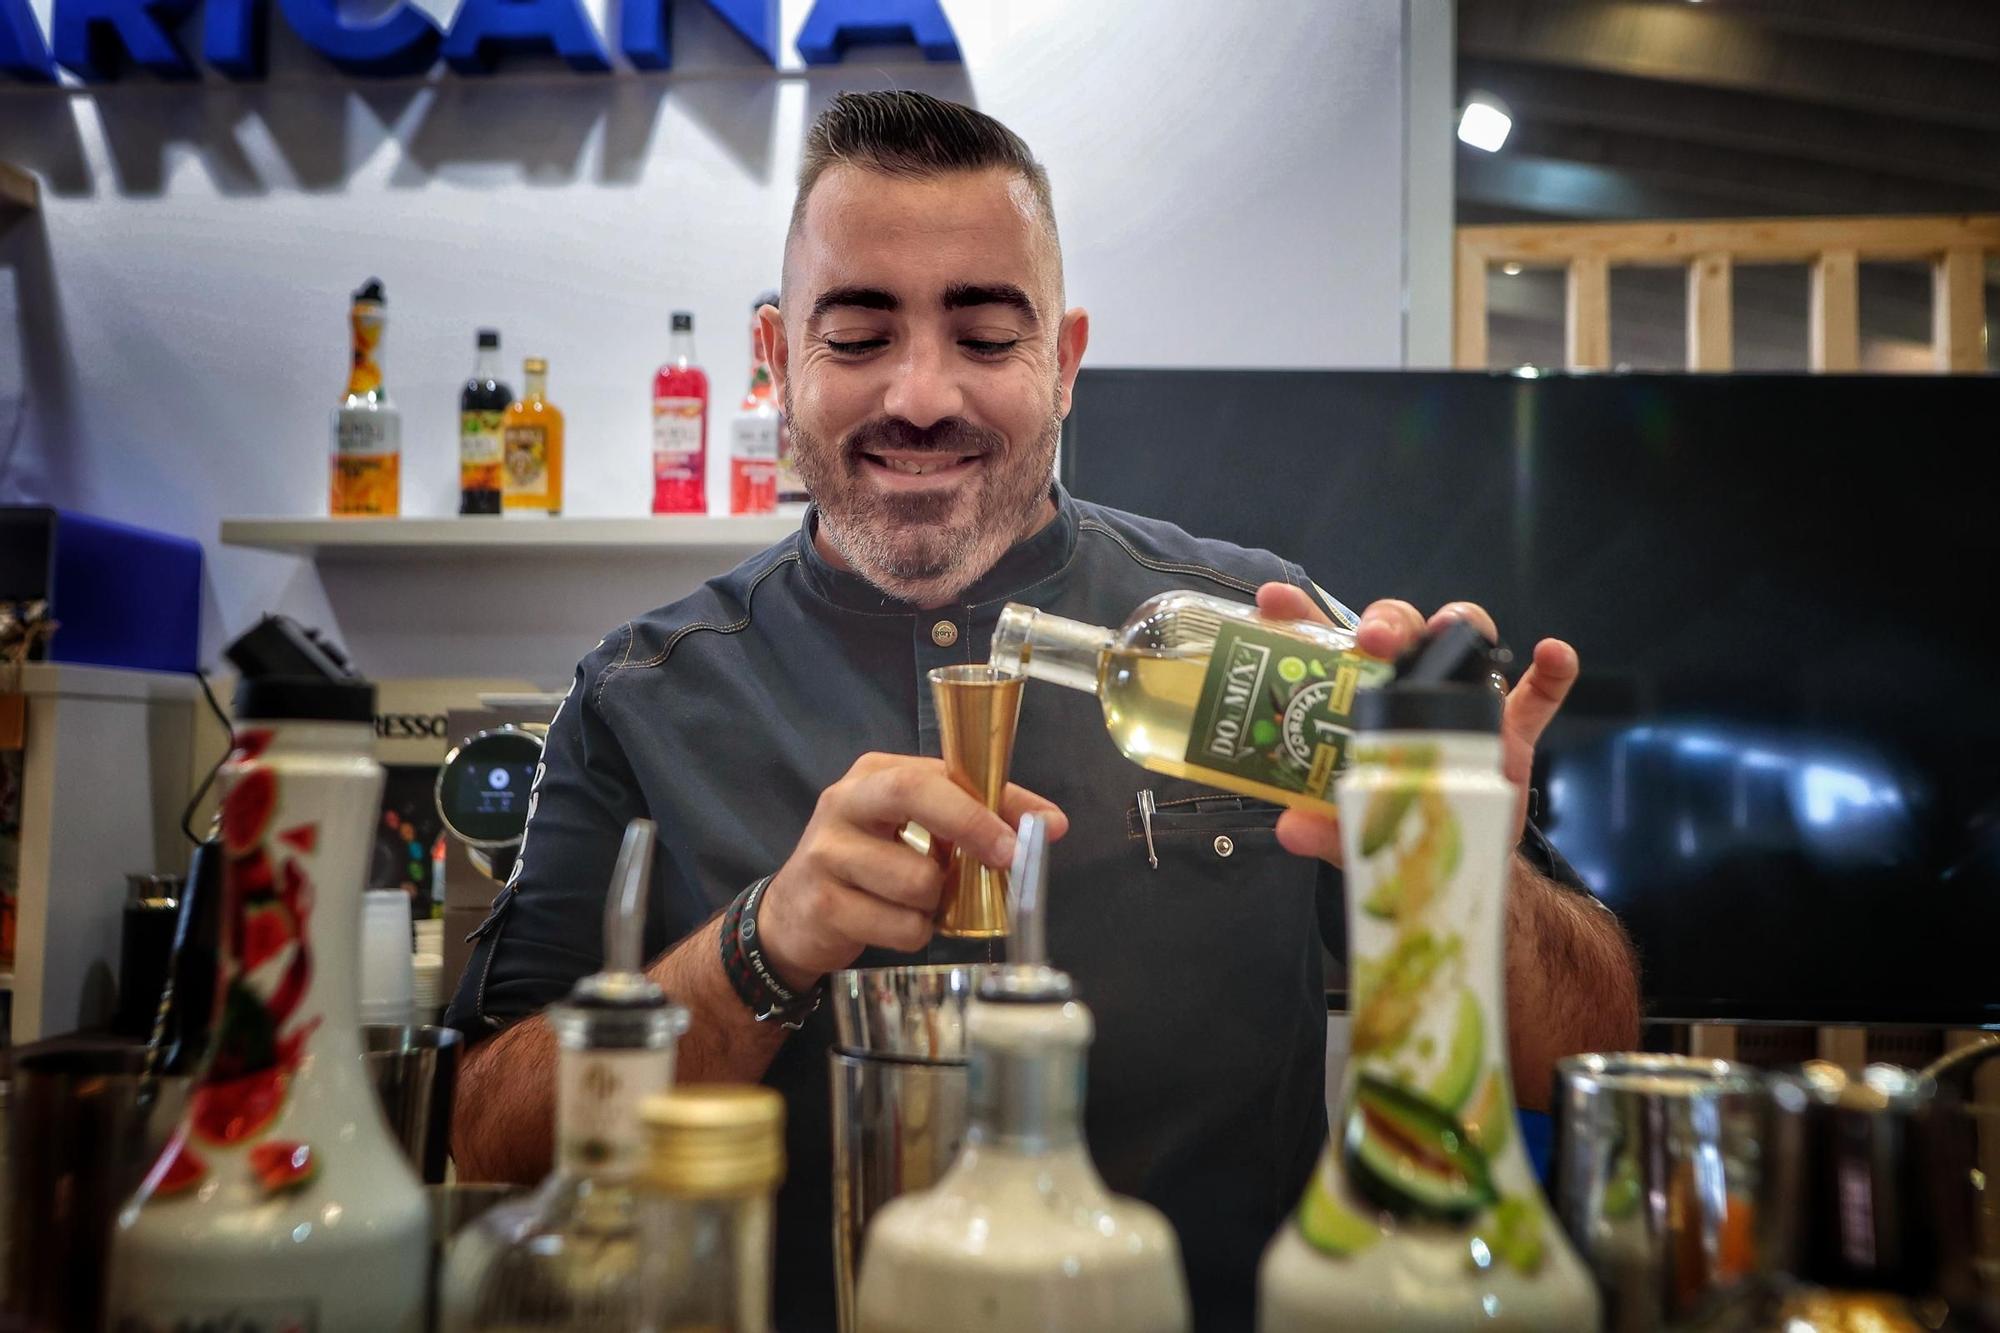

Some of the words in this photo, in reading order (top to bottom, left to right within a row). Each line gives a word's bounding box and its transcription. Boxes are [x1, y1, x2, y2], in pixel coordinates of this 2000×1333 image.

[0, 0, 961, 80] RICANA
[1210, 719, 1241, 757] DO
[1288, 687, 1330, 758] CORDIAL
